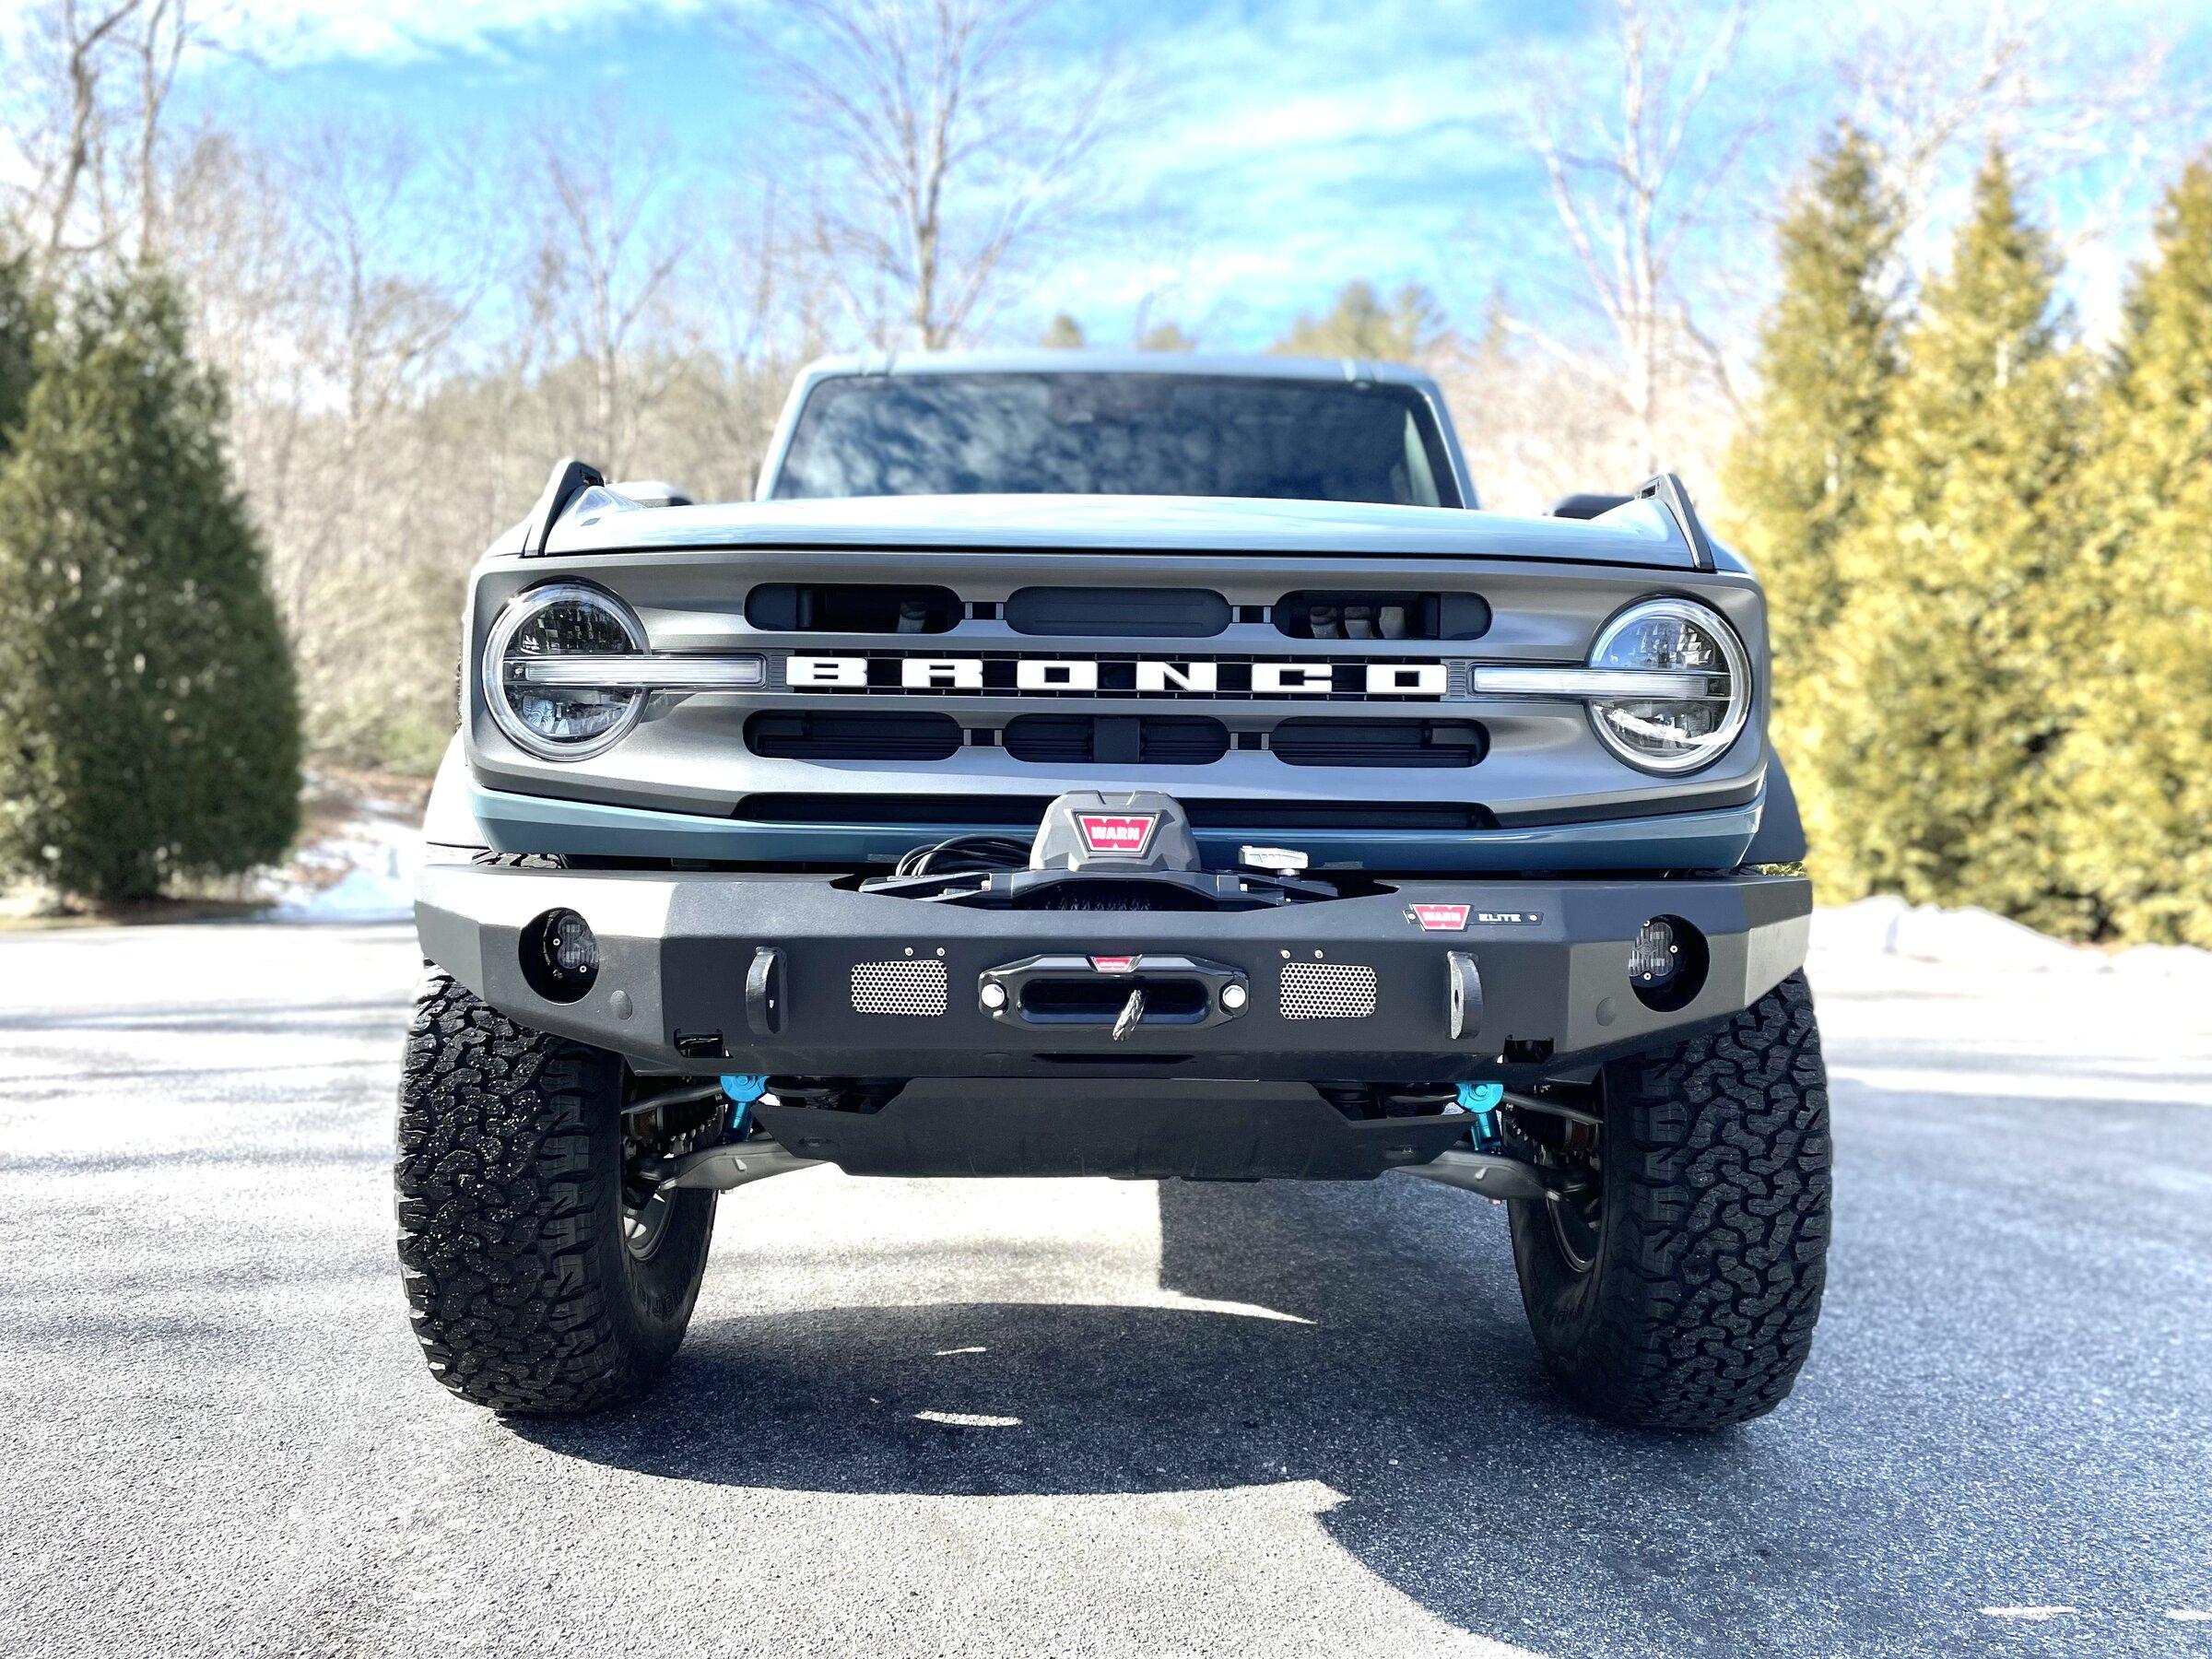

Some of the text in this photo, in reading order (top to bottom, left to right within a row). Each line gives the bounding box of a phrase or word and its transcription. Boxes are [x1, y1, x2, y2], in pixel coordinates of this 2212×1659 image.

[785, 655, 1449, 696] BRONCO
[1090, 826, 1140, 841] WARN
[1423, 912, 1522, 923] WARN ELITE
